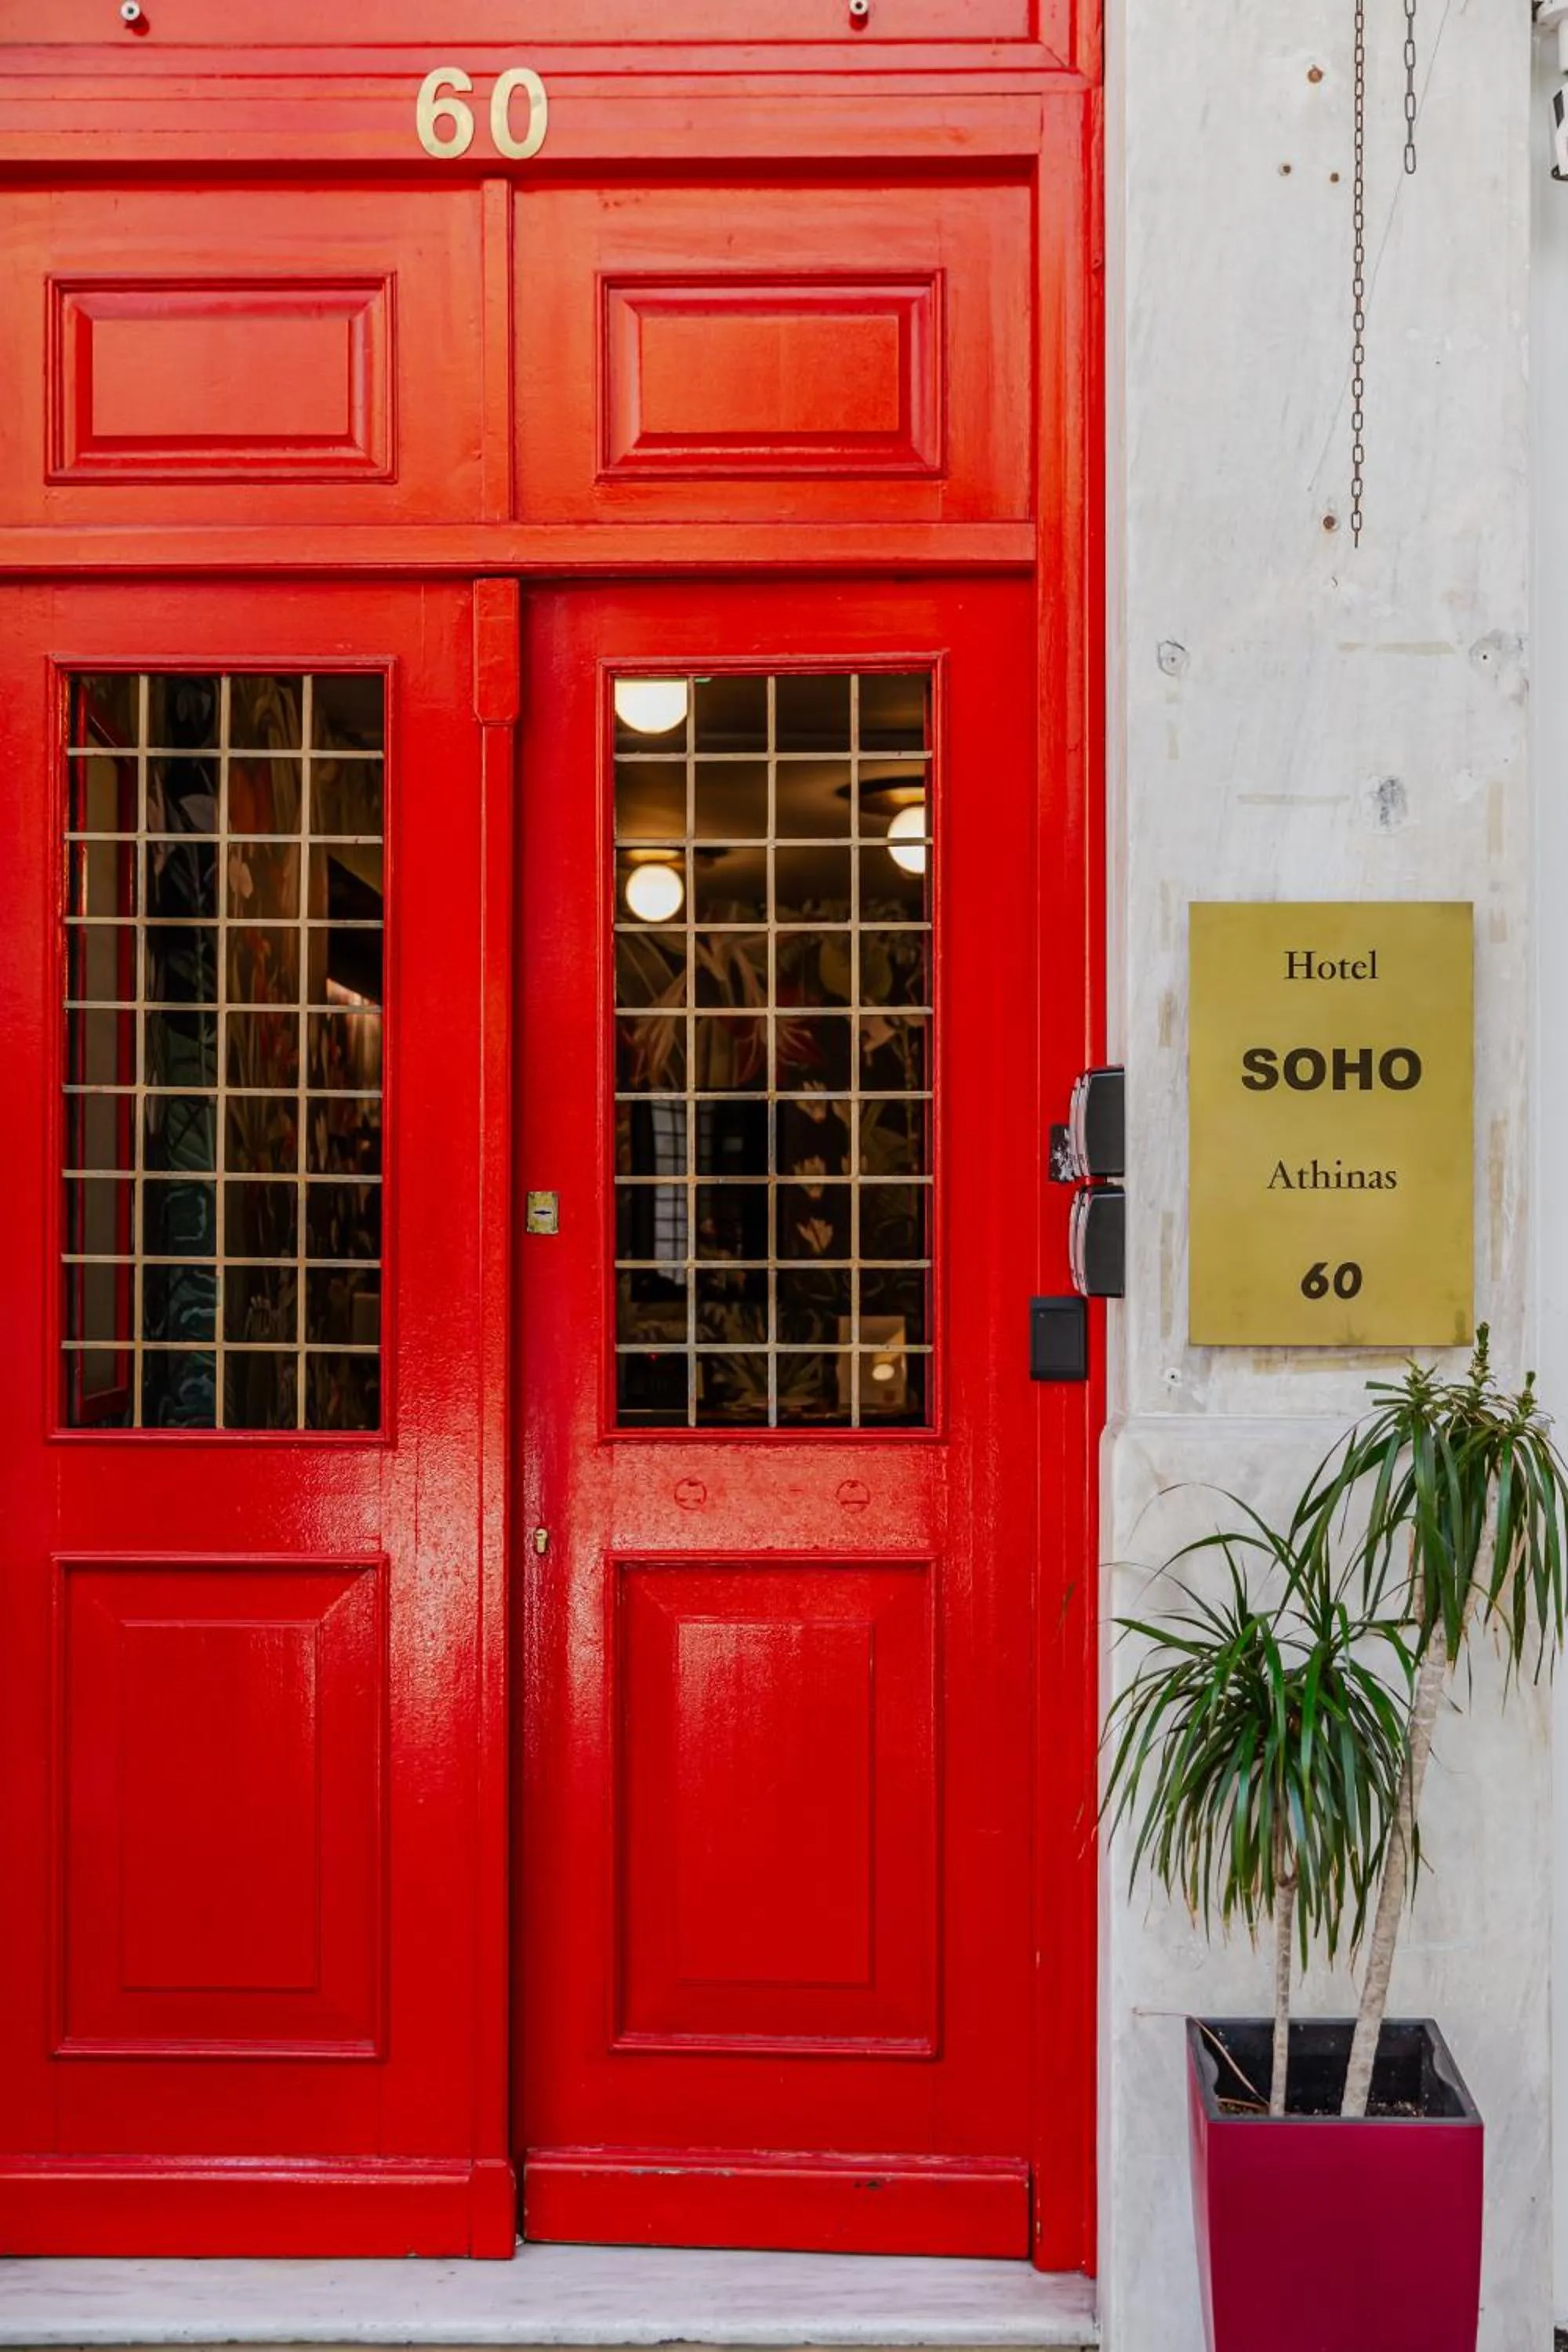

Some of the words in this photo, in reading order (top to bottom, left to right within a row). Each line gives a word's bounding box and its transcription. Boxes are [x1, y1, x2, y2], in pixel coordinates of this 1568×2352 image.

[416, 67, 548, 159] 60
[1283, 950, 1378, 980] Hotel
[1241, 1048, 1421, 1091] SOHO
[1267, 1160, 1397, 1189] Athinas
[1301, 1261, 1363, 1299] 60
